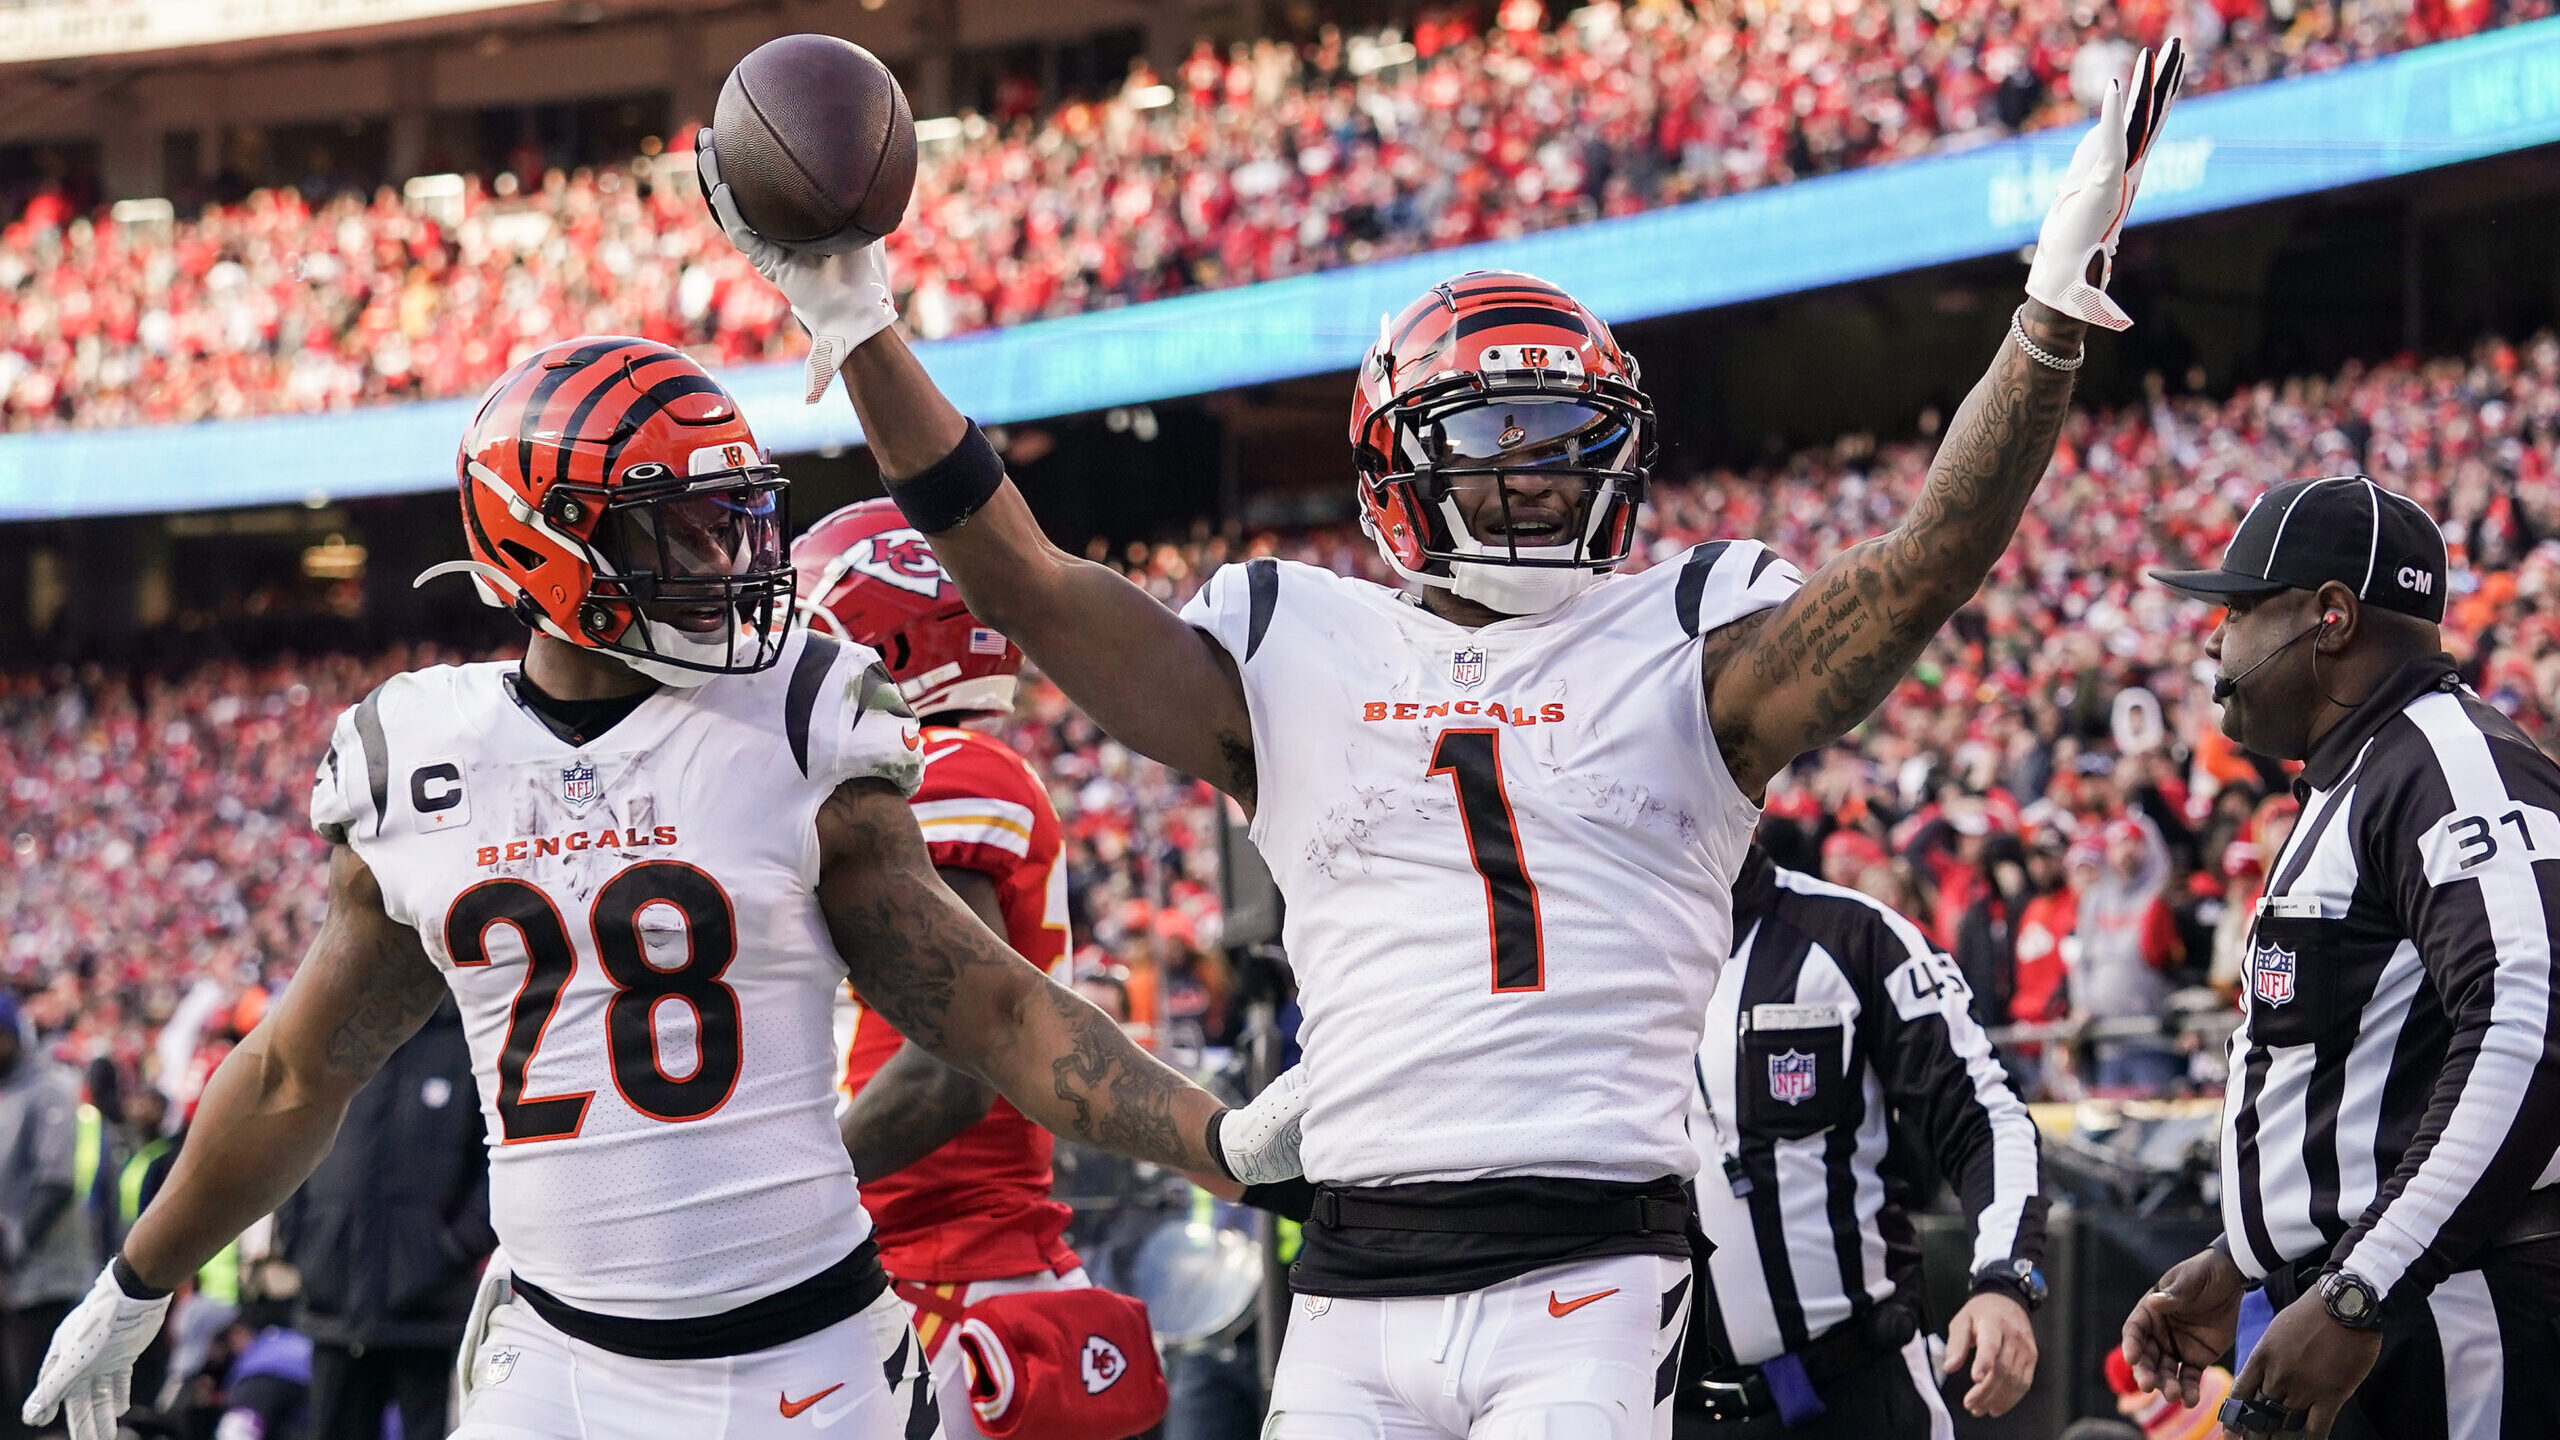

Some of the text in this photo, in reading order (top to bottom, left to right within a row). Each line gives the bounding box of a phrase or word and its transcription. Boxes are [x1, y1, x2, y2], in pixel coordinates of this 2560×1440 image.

[2397, 566, 2433, 595] CM
[1455, 664, 1479, 682] NFL
[1363, 701, 1565, 727] BENGALS
[411, 762, 462, 813] C
[567, 780, 593, 798] NFL
[476, 826, 677, 867] BENGALS
[2448, 810, 2536, 870] 31
[1426, 728, 1545, 994] 1
[2258, 971, 2290, 999] NFL
[444, 859, 743, 1145] 28
[1776, 1072, 1812, 1095] NFL
